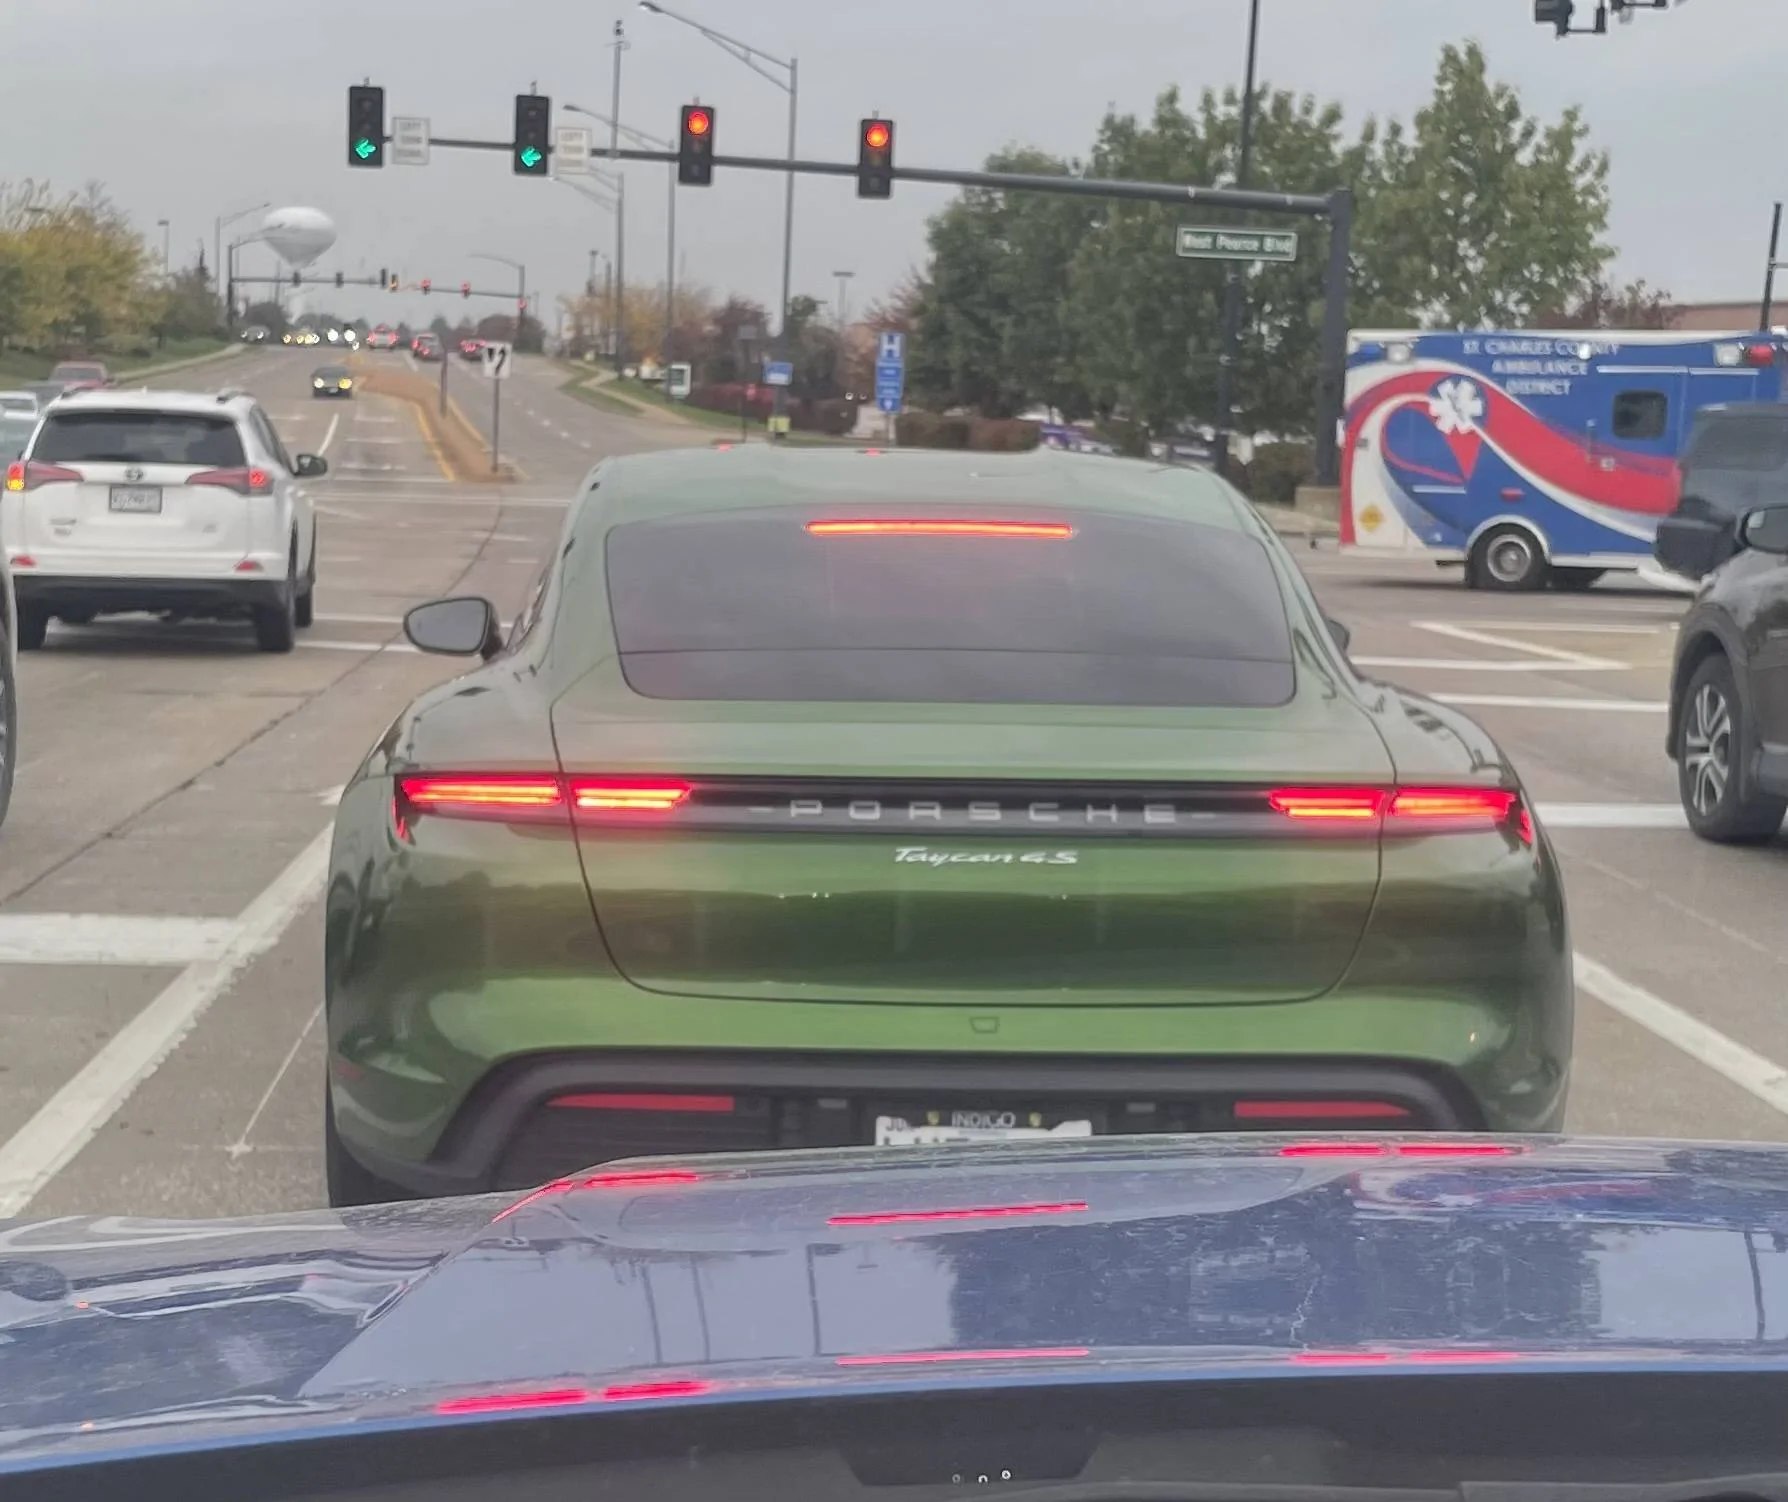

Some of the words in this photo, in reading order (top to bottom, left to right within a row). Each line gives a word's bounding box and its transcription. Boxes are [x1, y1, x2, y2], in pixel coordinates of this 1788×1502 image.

[880, 332, 901, 358] H
[1491, 359, 1588, 376] AMBULANCE
[1506, 378, 1571, 395] DISTRICT
[791, 799, 1176, 824] PORSCHE
[895, 846, 1014, 867] Taycan
[1020, 851, 1078, 864] 4S
[951, 1110, 1017, 1128] INDIGO
